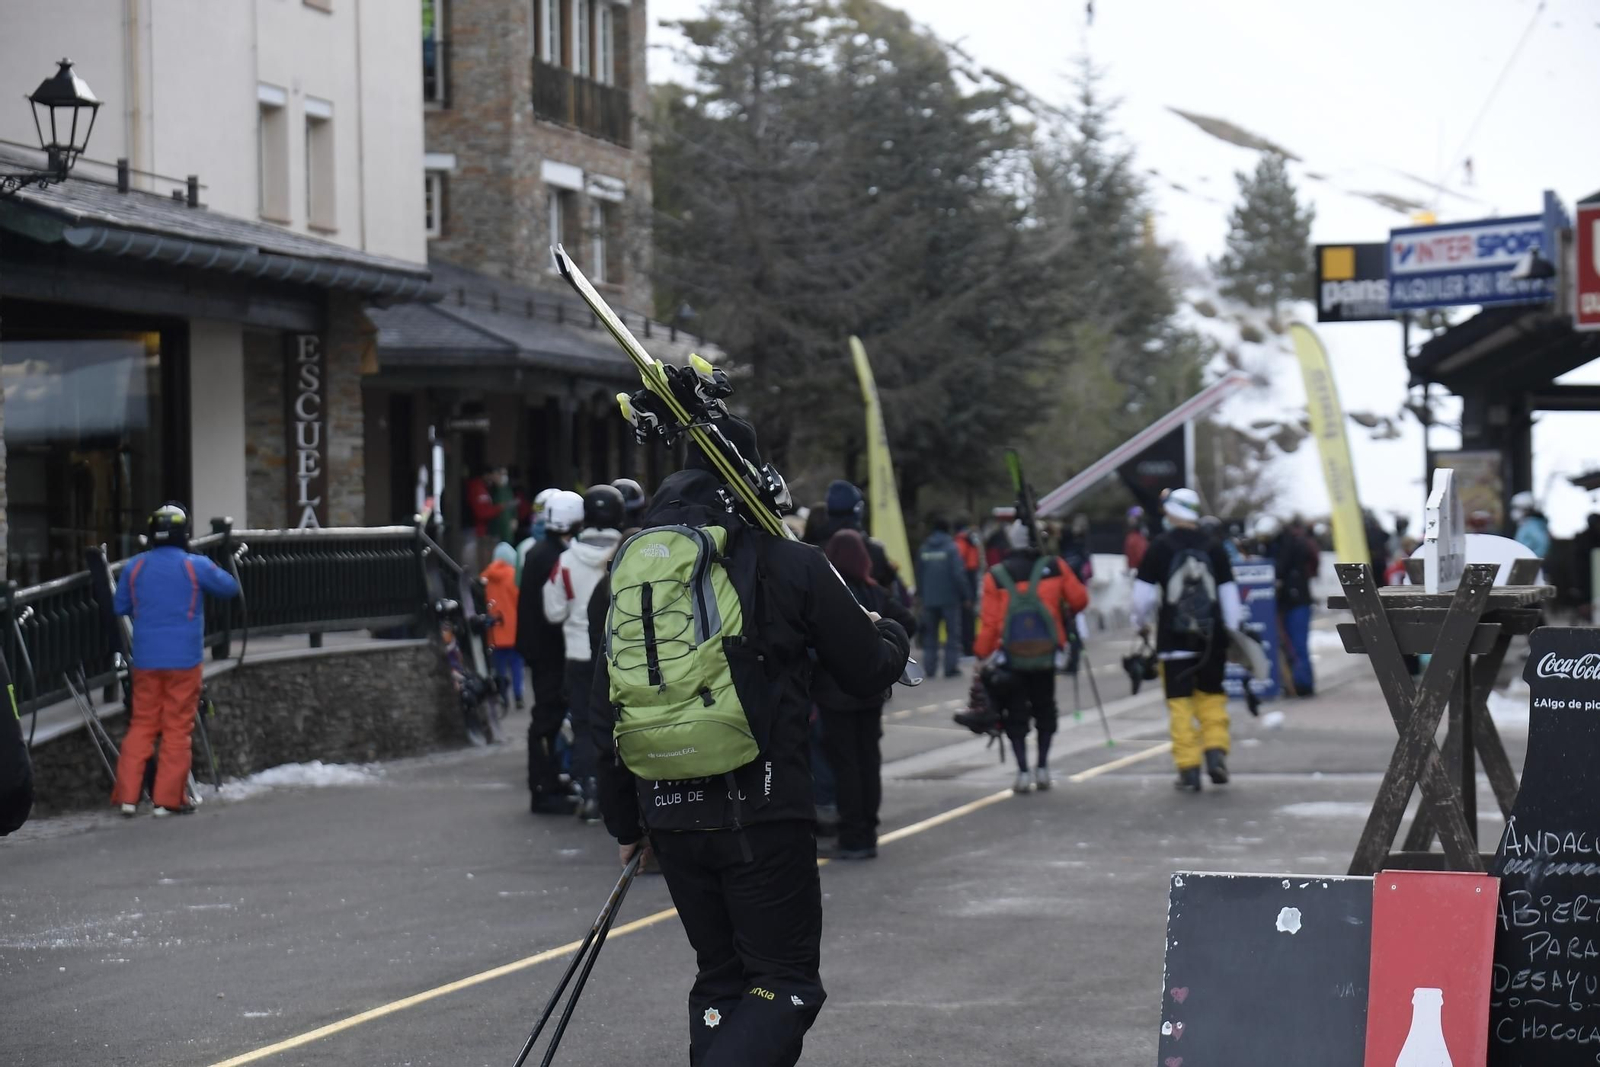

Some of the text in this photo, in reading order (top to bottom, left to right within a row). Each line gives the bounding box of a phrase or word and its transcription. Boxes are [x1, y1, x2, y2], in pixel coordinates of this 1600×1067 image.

[295, 334, 322, 528] ESCUELA
[1536, 651, 1600, 680] Coca-Col
[1534, 698, 1565, 710] ¿Algo
[1568, 699, 1582, 709] de
[764, 761, 772, 796] VITALINI
[654, 790, 704, 807] CLUB DE
[1522, 930, 1599, 963] PARA
